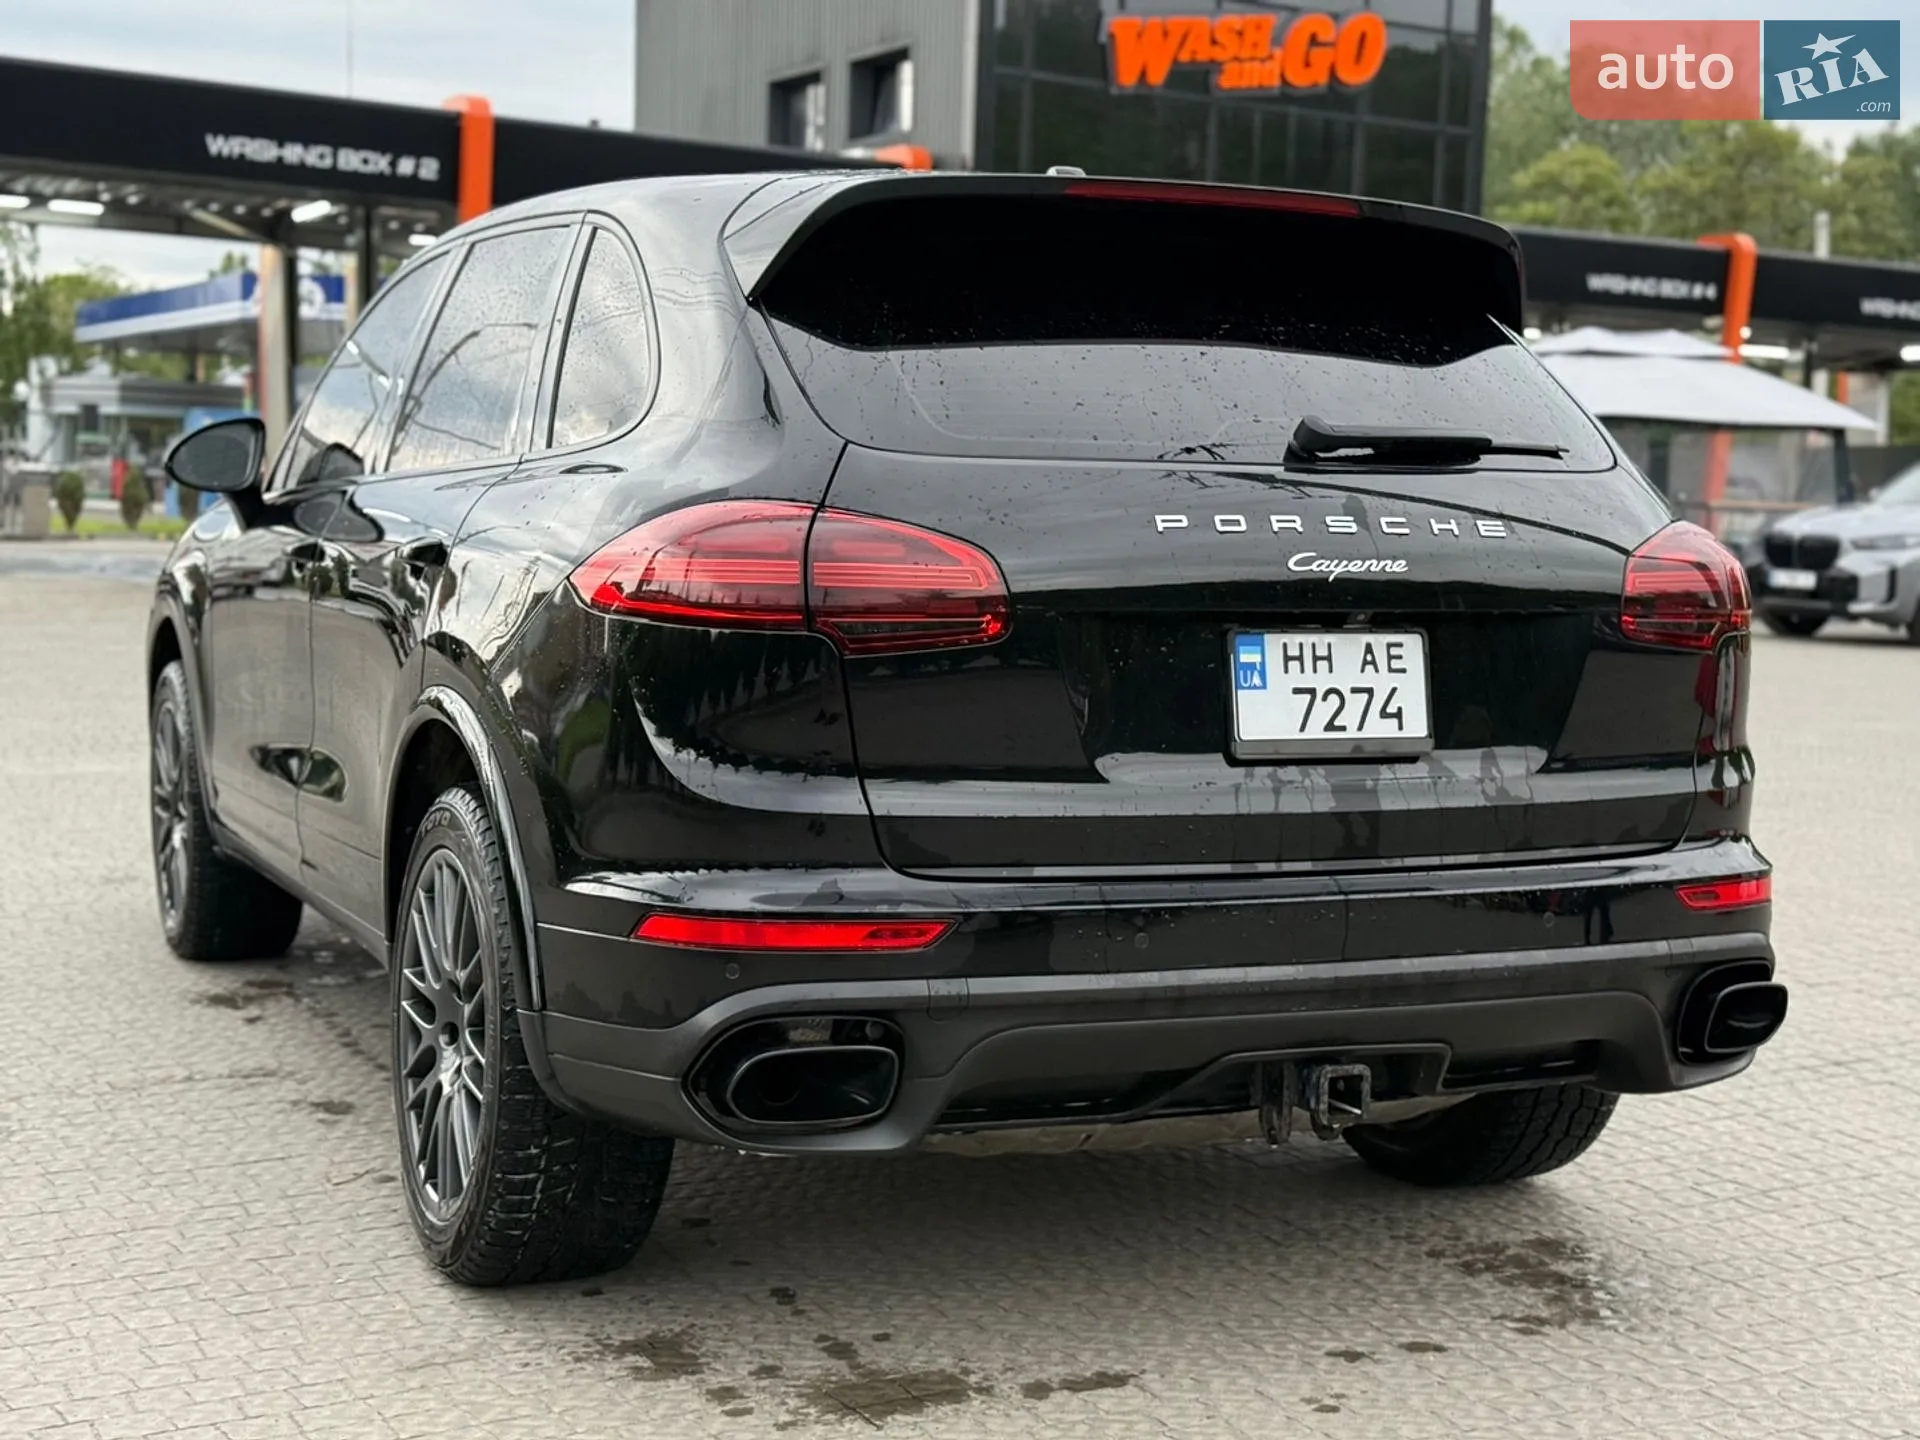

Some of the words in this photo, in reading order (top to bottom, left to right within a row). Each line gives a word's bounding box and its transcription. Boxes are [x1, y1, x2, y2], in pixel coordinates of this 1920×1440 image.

[1108, 14, 1278, 87] WASH
[1282, 11, 1388, 88] GO
[205, 132, 334, 170] WASHING
[336, 147, 394, 176] BOX
[396, 155, 416, 178] #
[418, 156, 440, 182] 2
[1154, 514, 1507, 537] PORSCHE
[1287, 552, 1409, 582] Cayenne
[1282, 641, 1334, 674] HH
[1360, 641, 1407, 674] AE
[1239, 669, 1263, 688] UA
[1291, 686, 1404, 733] 7274
